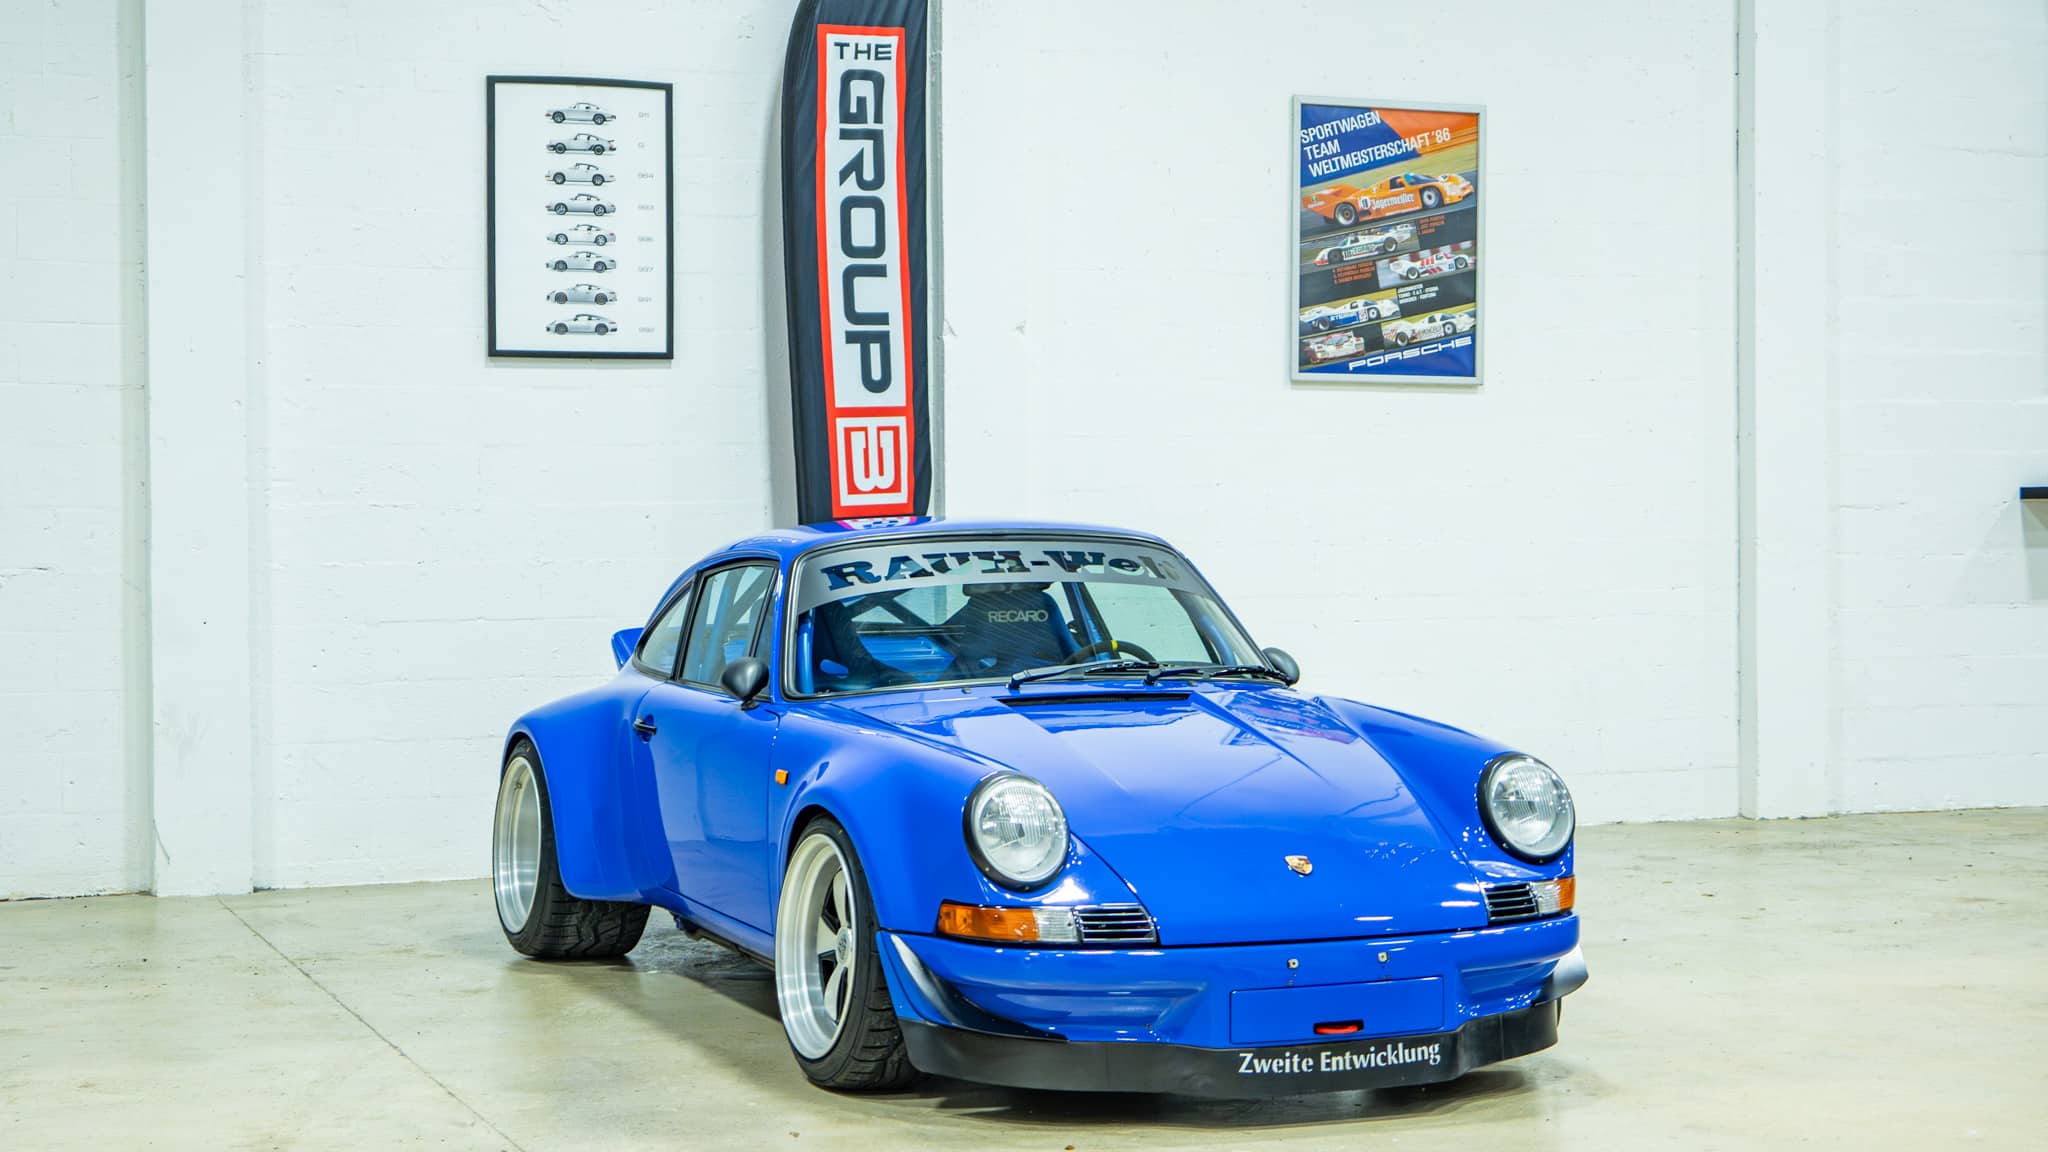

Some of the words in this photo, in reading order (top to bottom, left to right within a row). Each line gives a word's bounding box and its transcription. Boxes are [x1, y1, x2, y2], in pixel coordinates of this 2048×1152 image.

[834, 42, 892, 60] THE
[1301, 110, 1381, 144] SPORTWAGEN
[1304, 139, 1341, 160] TEAM
[1308, 132, 1431, 177] WELTMEISTERSCHAFT
[1431, 127, 1451, 144] '86
[839, 68, 893, 394] GROUP
[1348, 336, 1472, 371] PORSCHE
[988, 609, 1049, 623] RECARO
[1238, 1051, 1314, 1074] Zweite
[1320, 1042, 1441, 1072] Entwicklung
